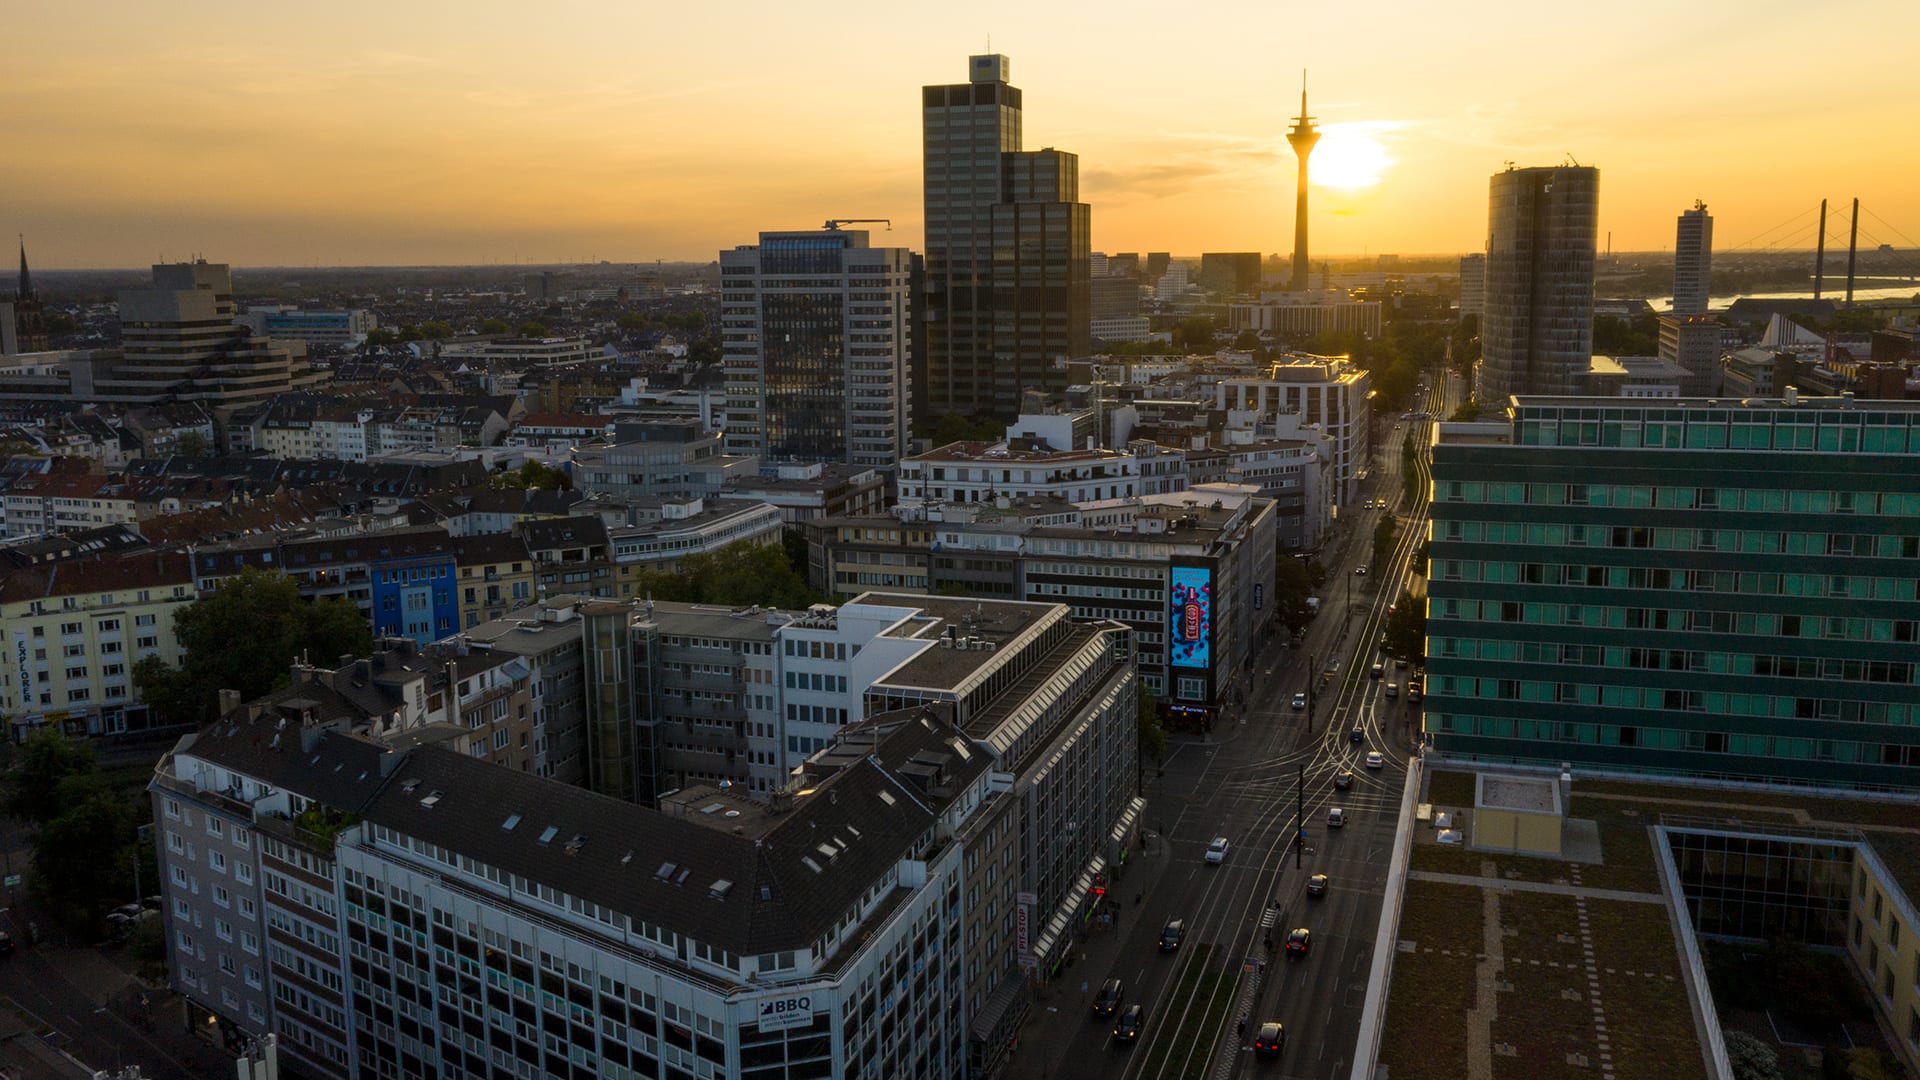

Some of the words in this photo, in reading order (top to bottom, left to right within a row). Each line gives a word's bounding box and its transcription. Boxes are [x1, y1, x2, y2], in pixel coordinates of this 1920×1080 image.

[18, 640, 32, 703] EXPLORER
[1018, 908, 1027, 950] PIT-STOP
[776, 997, 811, 1013] BBQ
